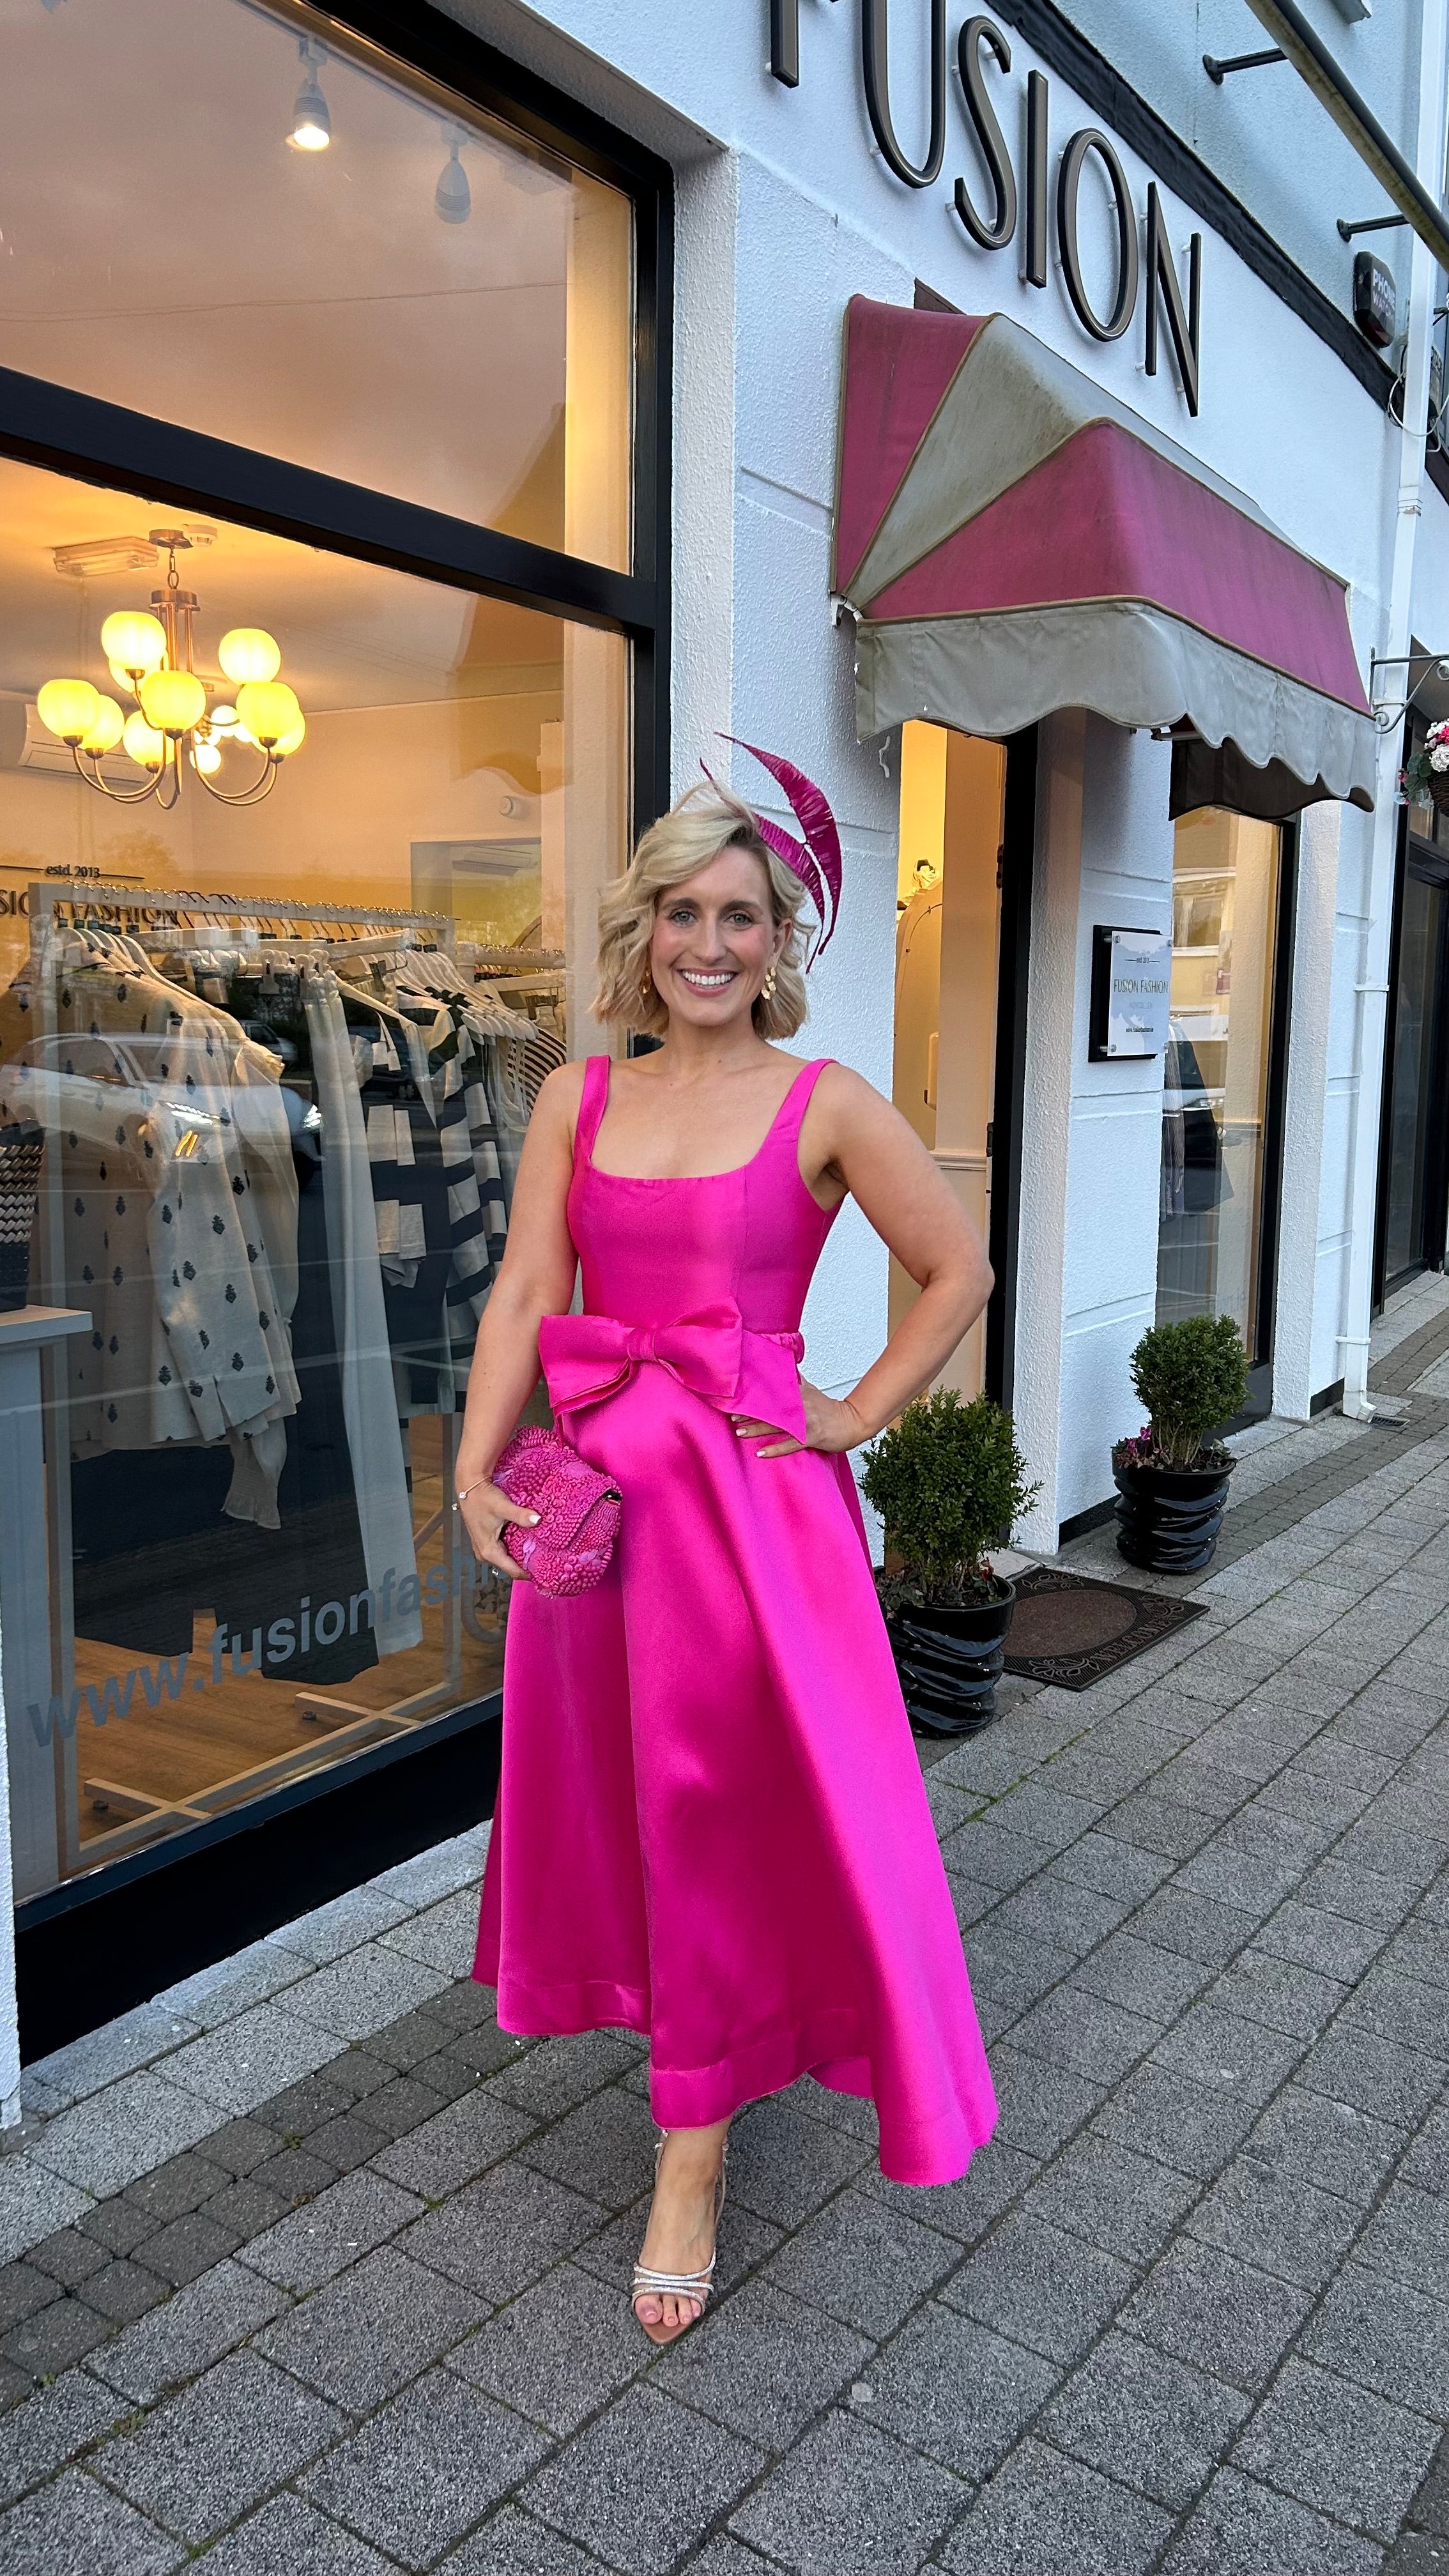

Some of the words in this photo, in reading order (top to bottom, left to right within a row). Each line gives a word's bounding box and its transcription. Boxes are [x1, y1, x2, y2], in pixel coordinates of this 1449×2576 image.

[1373, 268, 1395, 310] PHONE
[1373, 291, 1392, 318] WATC
[75, 866, 100, 878] 2013
[1114, 979, 1138, 993] FUSION
[1140, 979, 1168, 993] FASHION
[26, 1545, 509, 1748] www.fusionfashi
[1090, 1618, 1173, 1661] WELCOME
